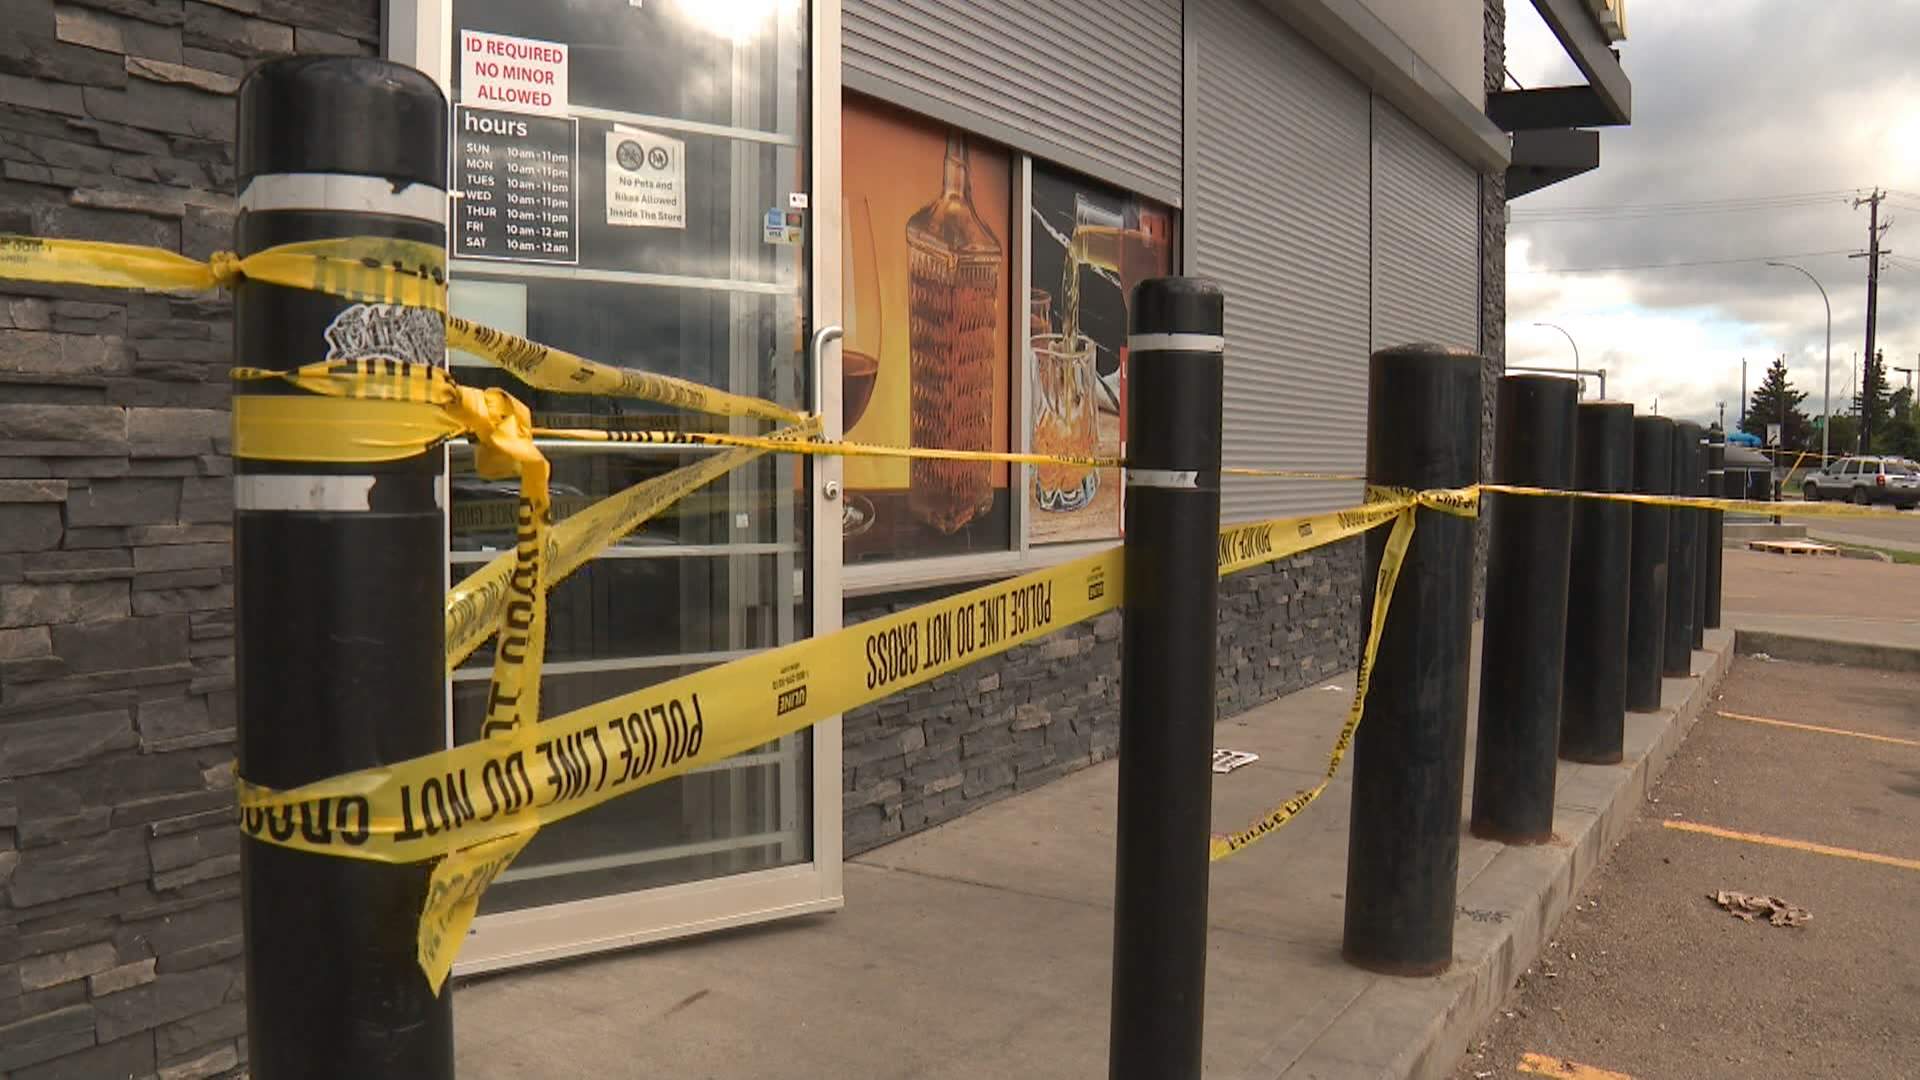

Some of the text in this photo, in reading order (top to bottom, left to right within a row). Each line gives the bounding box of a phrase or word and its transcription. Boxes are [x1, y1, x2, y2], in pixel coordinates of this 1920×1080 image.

[466, 37, 563, 64] ID REQUIRED
[475, 61, 554, 85] NO MINOR
[478, 85, 552, 106] ALLOWED
[465, 111, 527, 136] hours
[466, 143, 490, 154] SUN
[466, 159, 493, 170] MON
[467, 174, 495, 186] TUES
[466, 190, 492, 200] WED
[641, 193, 677, 206] Allowed
[467, 205, 496, 217] THUR
[466, 221, 483, 232] FRI
[466, 237, 487, 248] SAT
[1011, 580, 1053, 636] POLICE
[957, 605, 975, 657] DO
[979, 594, 1007, 648] LINE
[923, 612, 951, 669] NOT
[865, 621, 919, 690] CROSS
[612, 693, 703, 787] POLICE
[536, 728, 607, 806] LINE
[482, 750, 534, 823] DO
[394, 767, 477, 843] NOT
